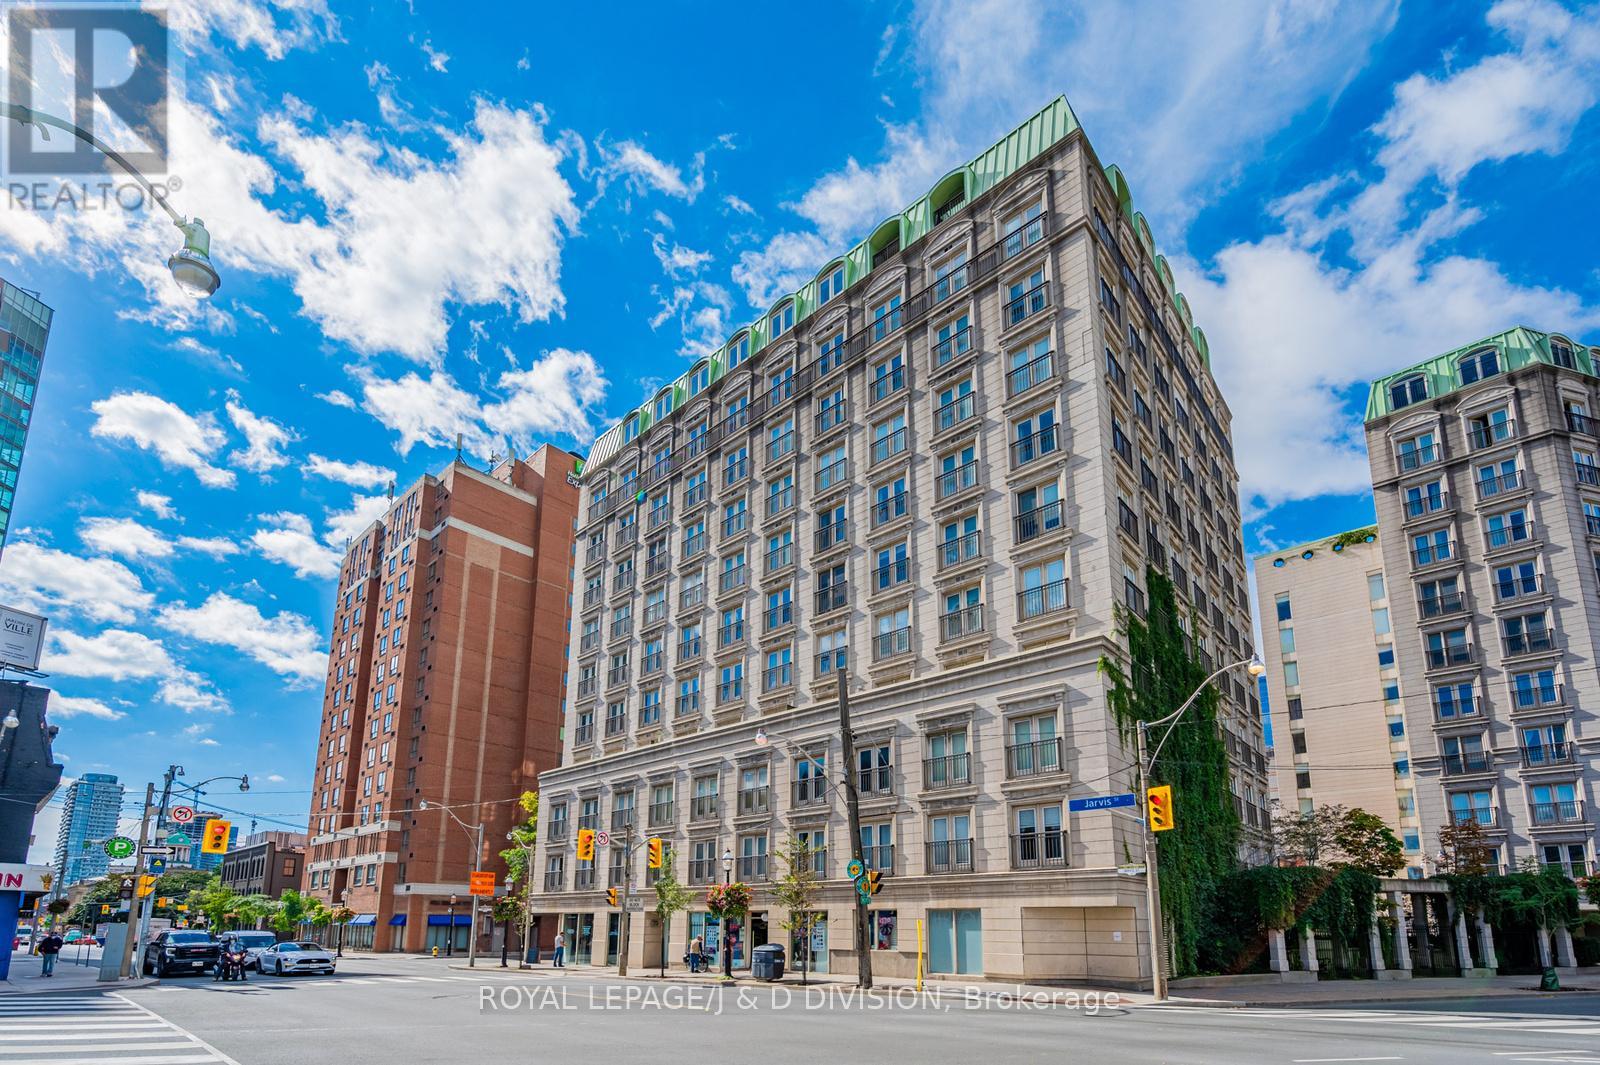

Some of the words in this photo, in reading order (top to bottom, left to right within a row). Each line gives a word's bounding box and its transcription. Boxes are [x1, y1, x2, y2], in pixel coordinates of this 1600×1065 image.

[4, 620, 32, 635] VILLE
[1084, 798, 1112, 808] Jarvis
[114, 842, 127, 852] P
